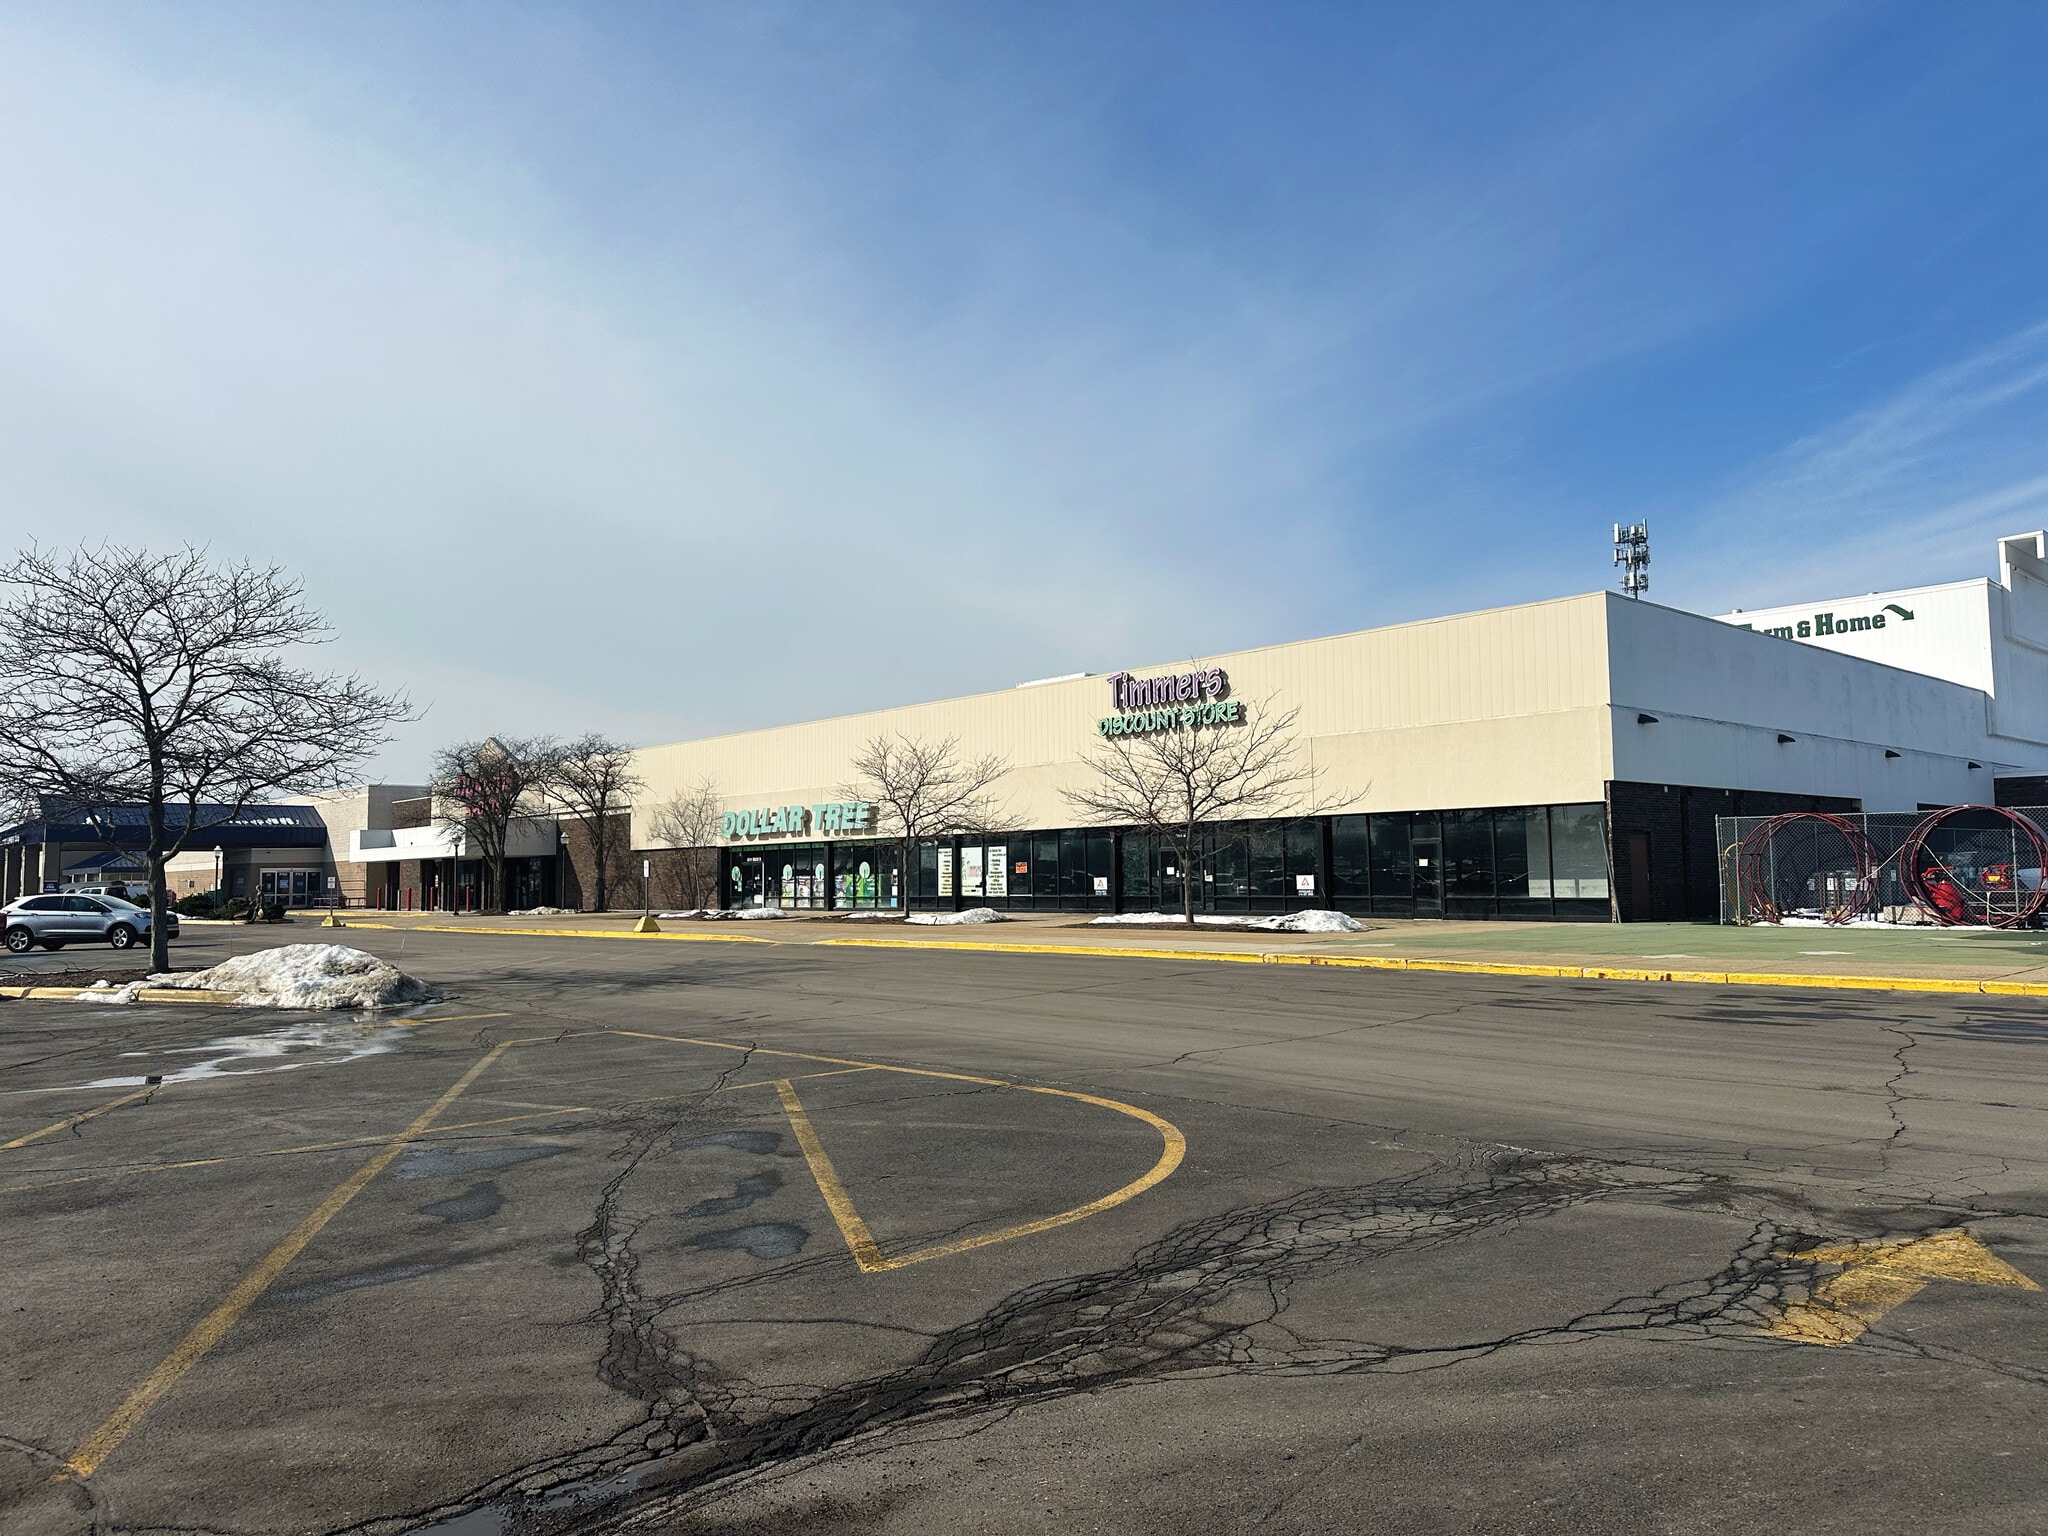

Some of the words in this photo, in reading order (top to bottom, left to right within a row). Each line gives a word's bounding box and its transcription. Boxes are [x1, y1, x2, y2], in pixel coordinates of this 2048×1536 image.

[1736, 623, 1794, 640] rm
[1797, 620, 1811, 638] &
[1814, 612, 1886, 637] Home
[1106, 667, 1224, 709] Timmers
[1097, 707, 1179, 736] DISCOUNT
[1182, 701, 1240, 727] STORE
[721, 805, 805, 837] DOLLAR
[811, 801, 871, 831] TREE
